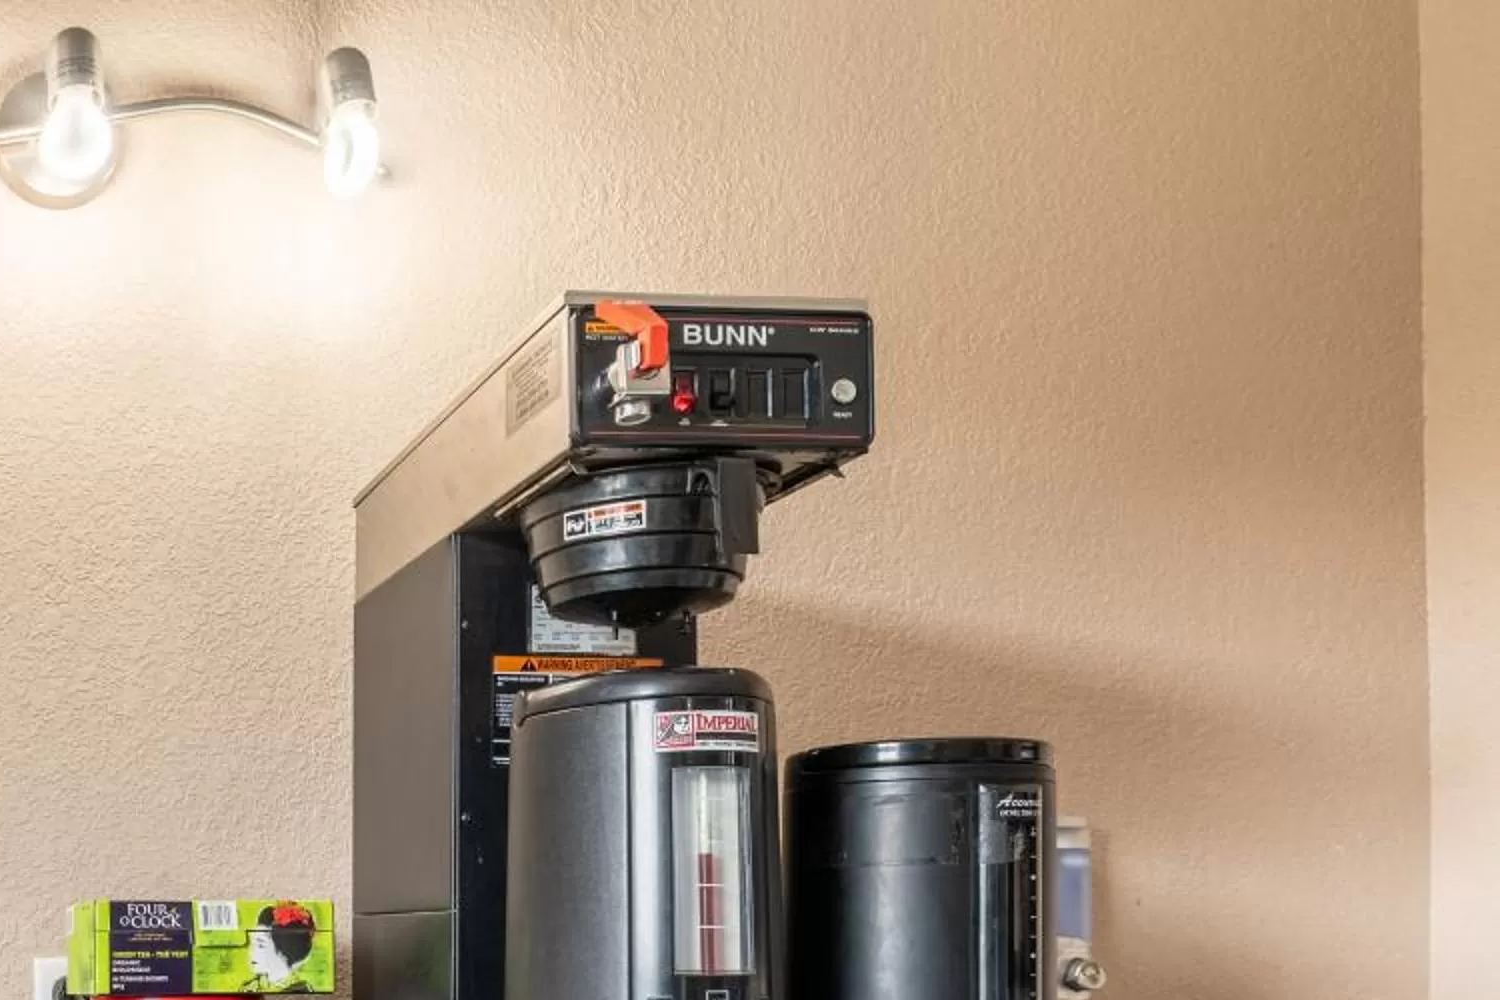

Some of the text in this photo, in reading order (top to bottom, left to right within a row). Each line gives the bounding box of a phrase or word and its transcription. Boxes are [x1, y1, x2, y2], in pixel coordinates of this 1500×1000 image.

[682, 323, 768, 347] BUNN
[696, 713, 757, 732] IMPERIAL
[127, 903, 169, 917] FOUR
